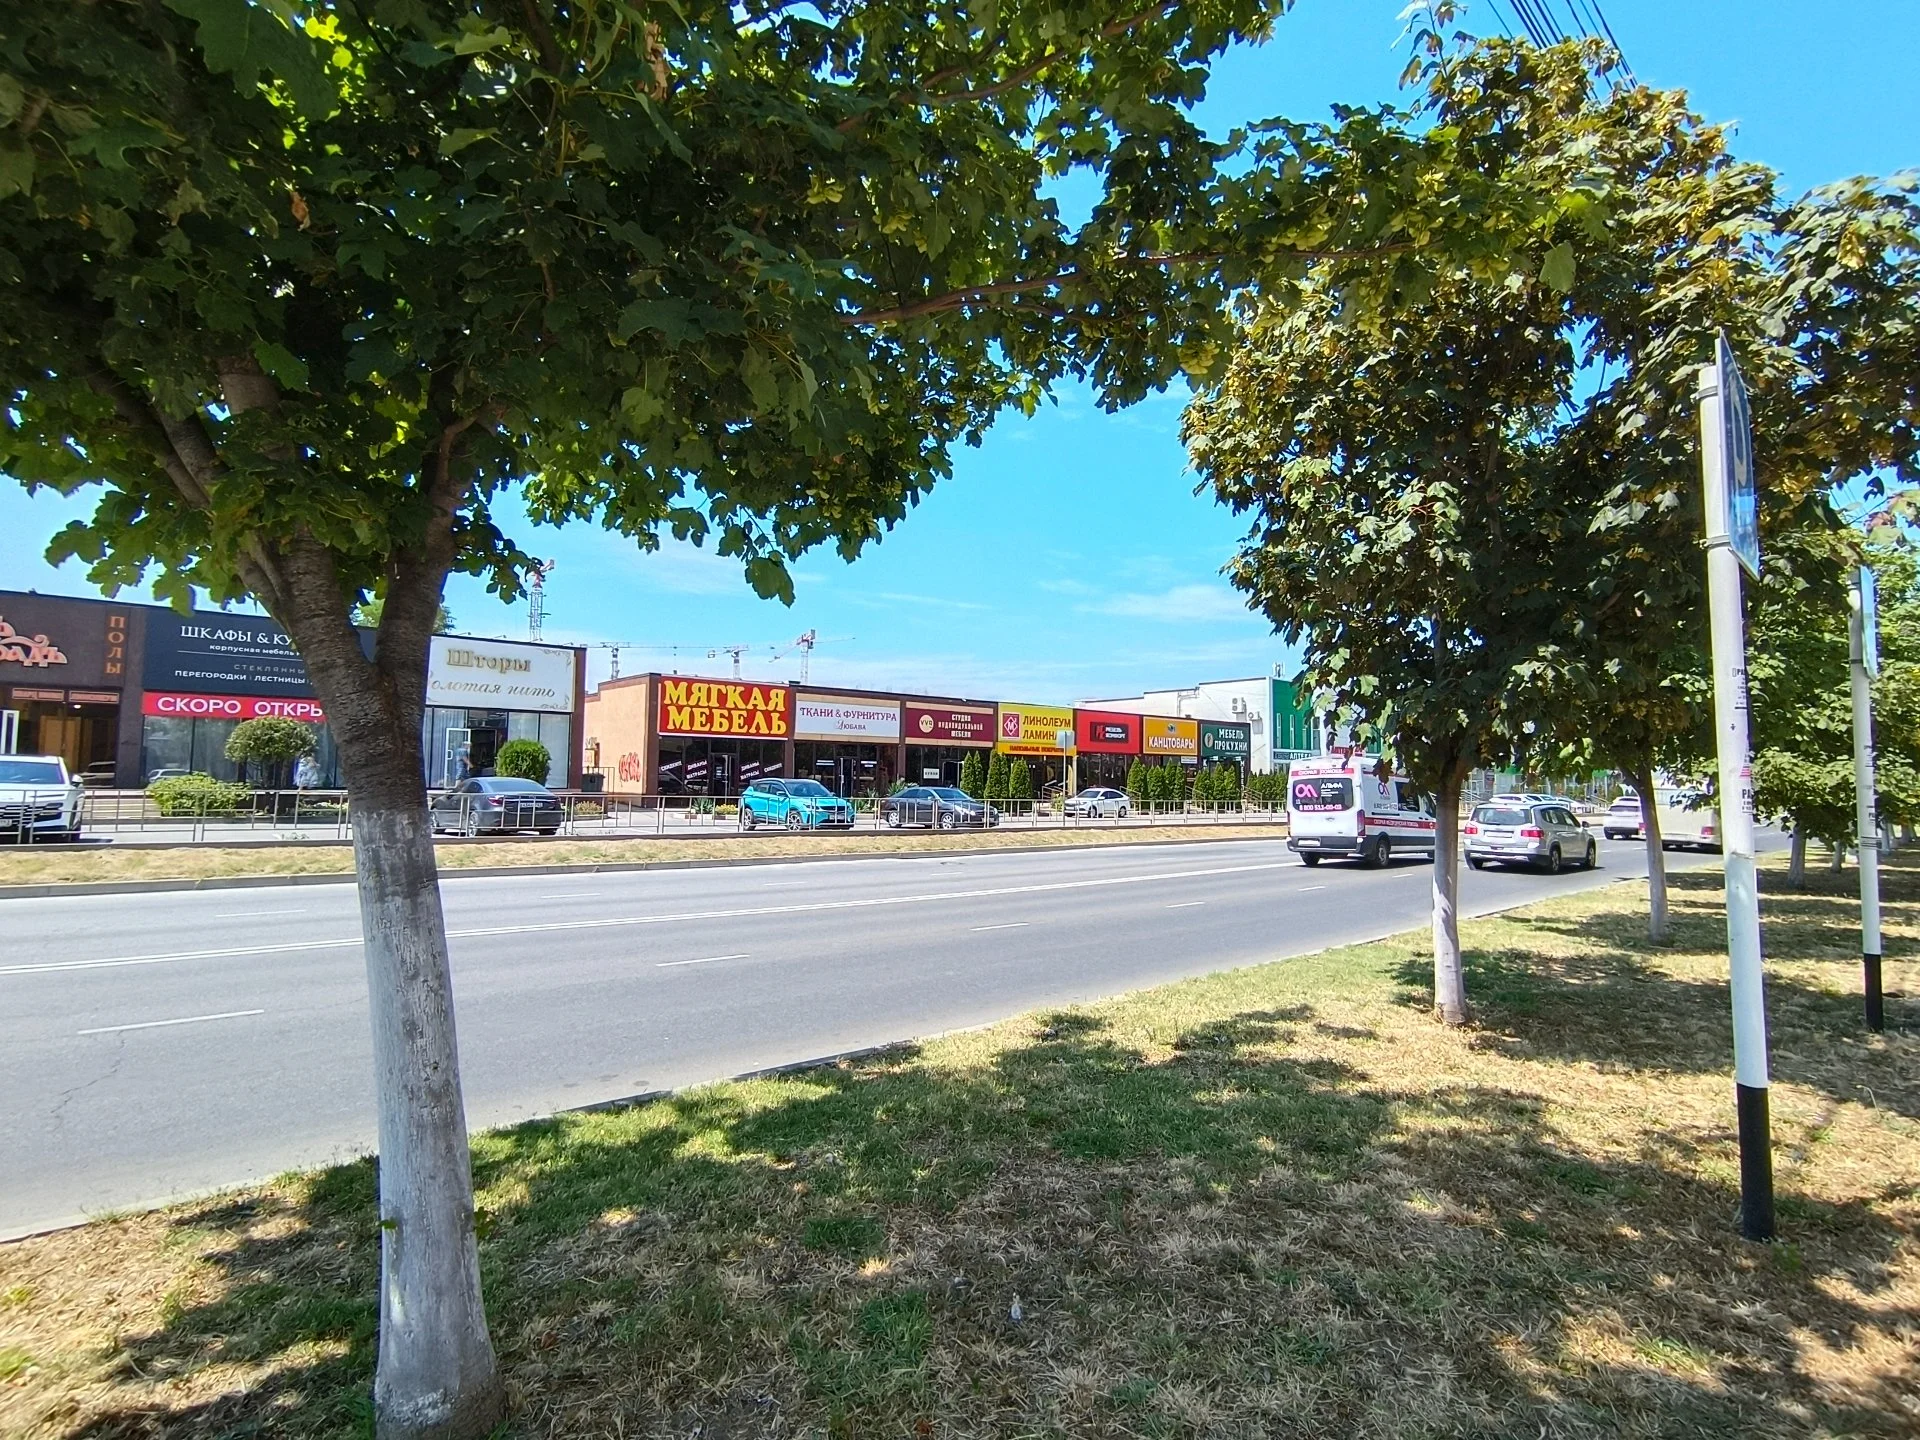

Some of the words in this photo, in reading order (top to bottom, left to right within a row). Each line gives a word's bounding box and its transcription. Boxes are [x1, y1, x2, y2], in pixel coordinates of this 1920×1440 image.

[181, 625, 251, 643] ШКАФЫ
[257, 632, 270, 644] &
[105, 615, 125, 674] ПОЛЫ
[209, 644, 260, 654] корпусная
[262, 648, 295, 657] мебель
[233, 664, 305, 674] СТЕКЛЯННЫ
[446, 649, 531, 674] Шторы
[174, 670, 247, 681] ПЕРЕГОРОДКИ
[254, 675, 306, 685] ЛЕСТНИЦЫ
[431, 679, 501, 694] олотая
[663, 680, 786, 712] МЯГКАЯ
[157, 696, 242, 714] СКОРО
[666, 705, 787, 735] МЕБЕЛЬ
[799, 706, 834, 718] ТКАНИ
[843, 710, 897, 721] ФУРНИТУРА
[1022, 715, 1071, 728] ЛИНОЛЕУМ
[1022, 729, 1057, 741] ЛАМИН
[1218, 728, 1244, 740] МЕБЕЛЬ
[1148, 736, 1195, 750] КАНЦТОВАРЫ
